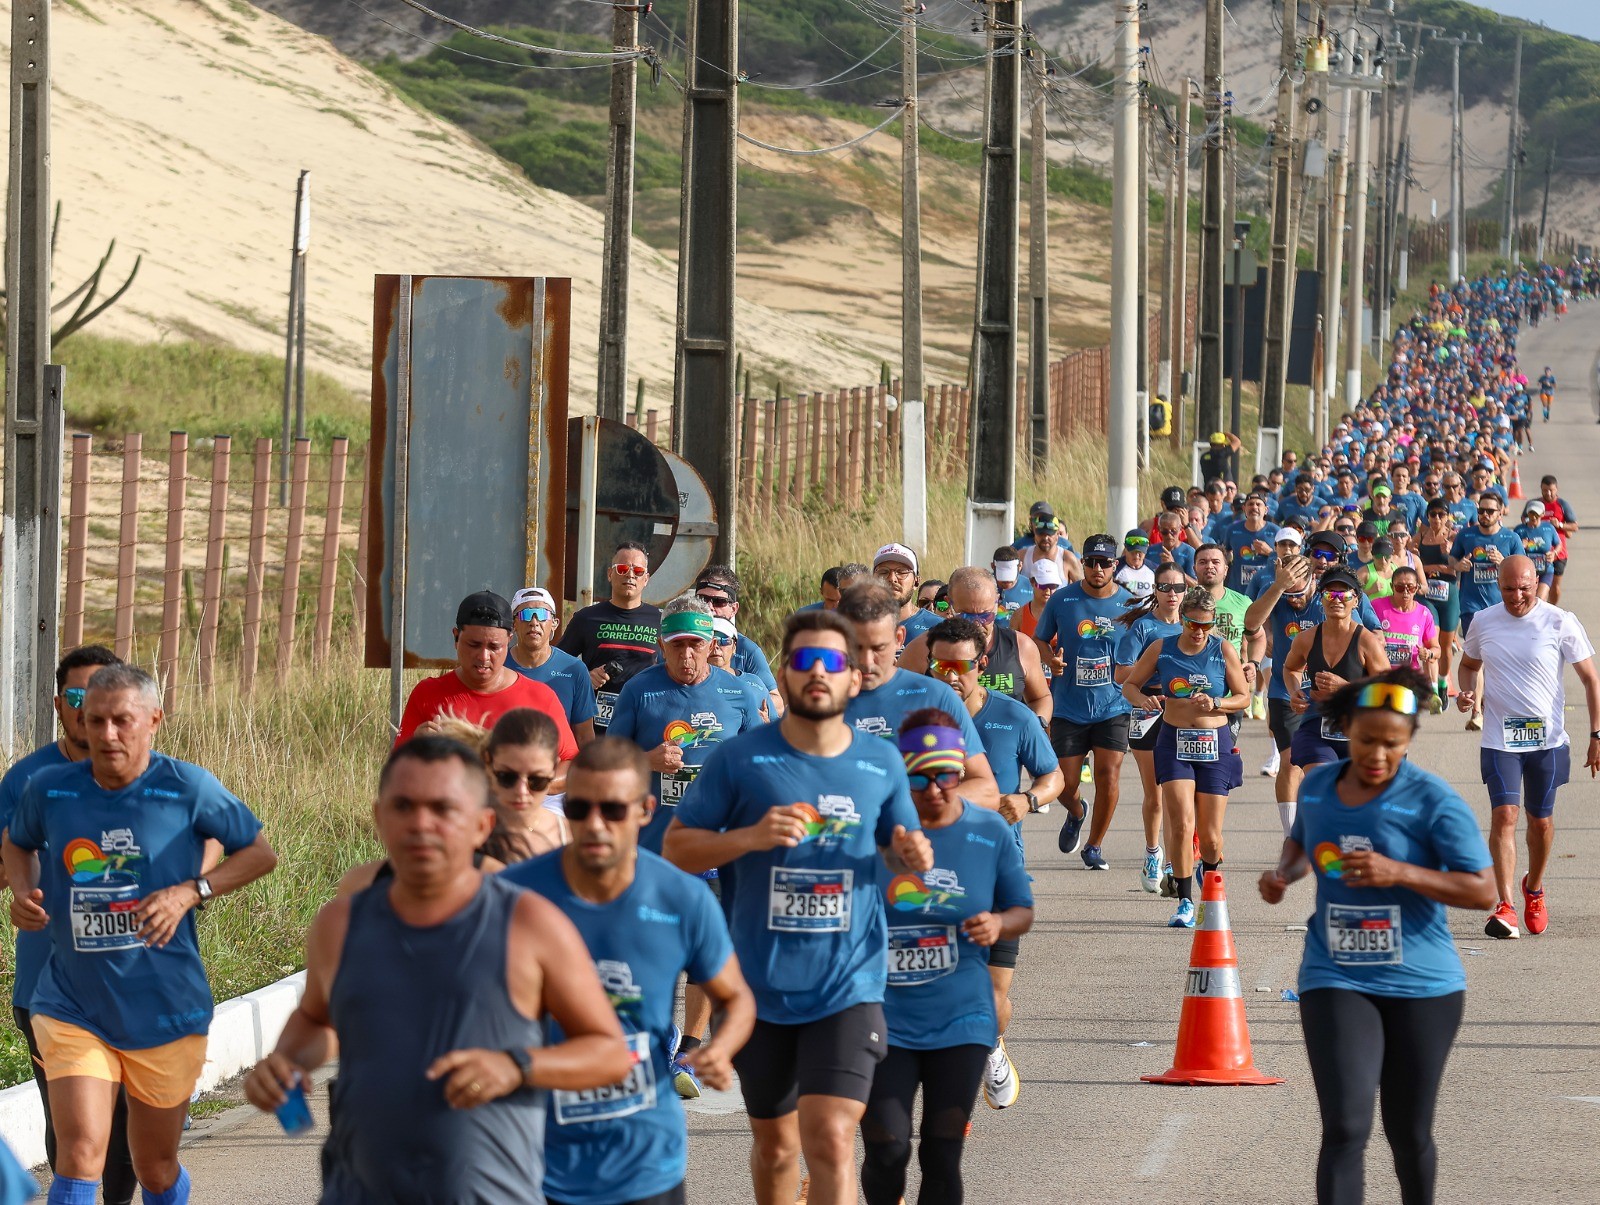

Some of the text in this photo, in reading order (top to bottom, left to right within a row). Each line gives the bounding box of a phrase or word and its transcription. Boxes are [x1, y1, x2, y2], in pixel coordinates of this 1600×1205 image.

[600, 623, 658, 635] CANAL MAIS
[596, 631, 658, 645] CORREDORES
[1512, 728, 1539, 741] 21705
[1184, 741, 1212, 754] 26664
[101, 838, 141, 851] SOL
[786, 894, 838, 916] 23653
[1339, 929, 1389, 951] 23093
[895, 947, 945, 971] 22321
